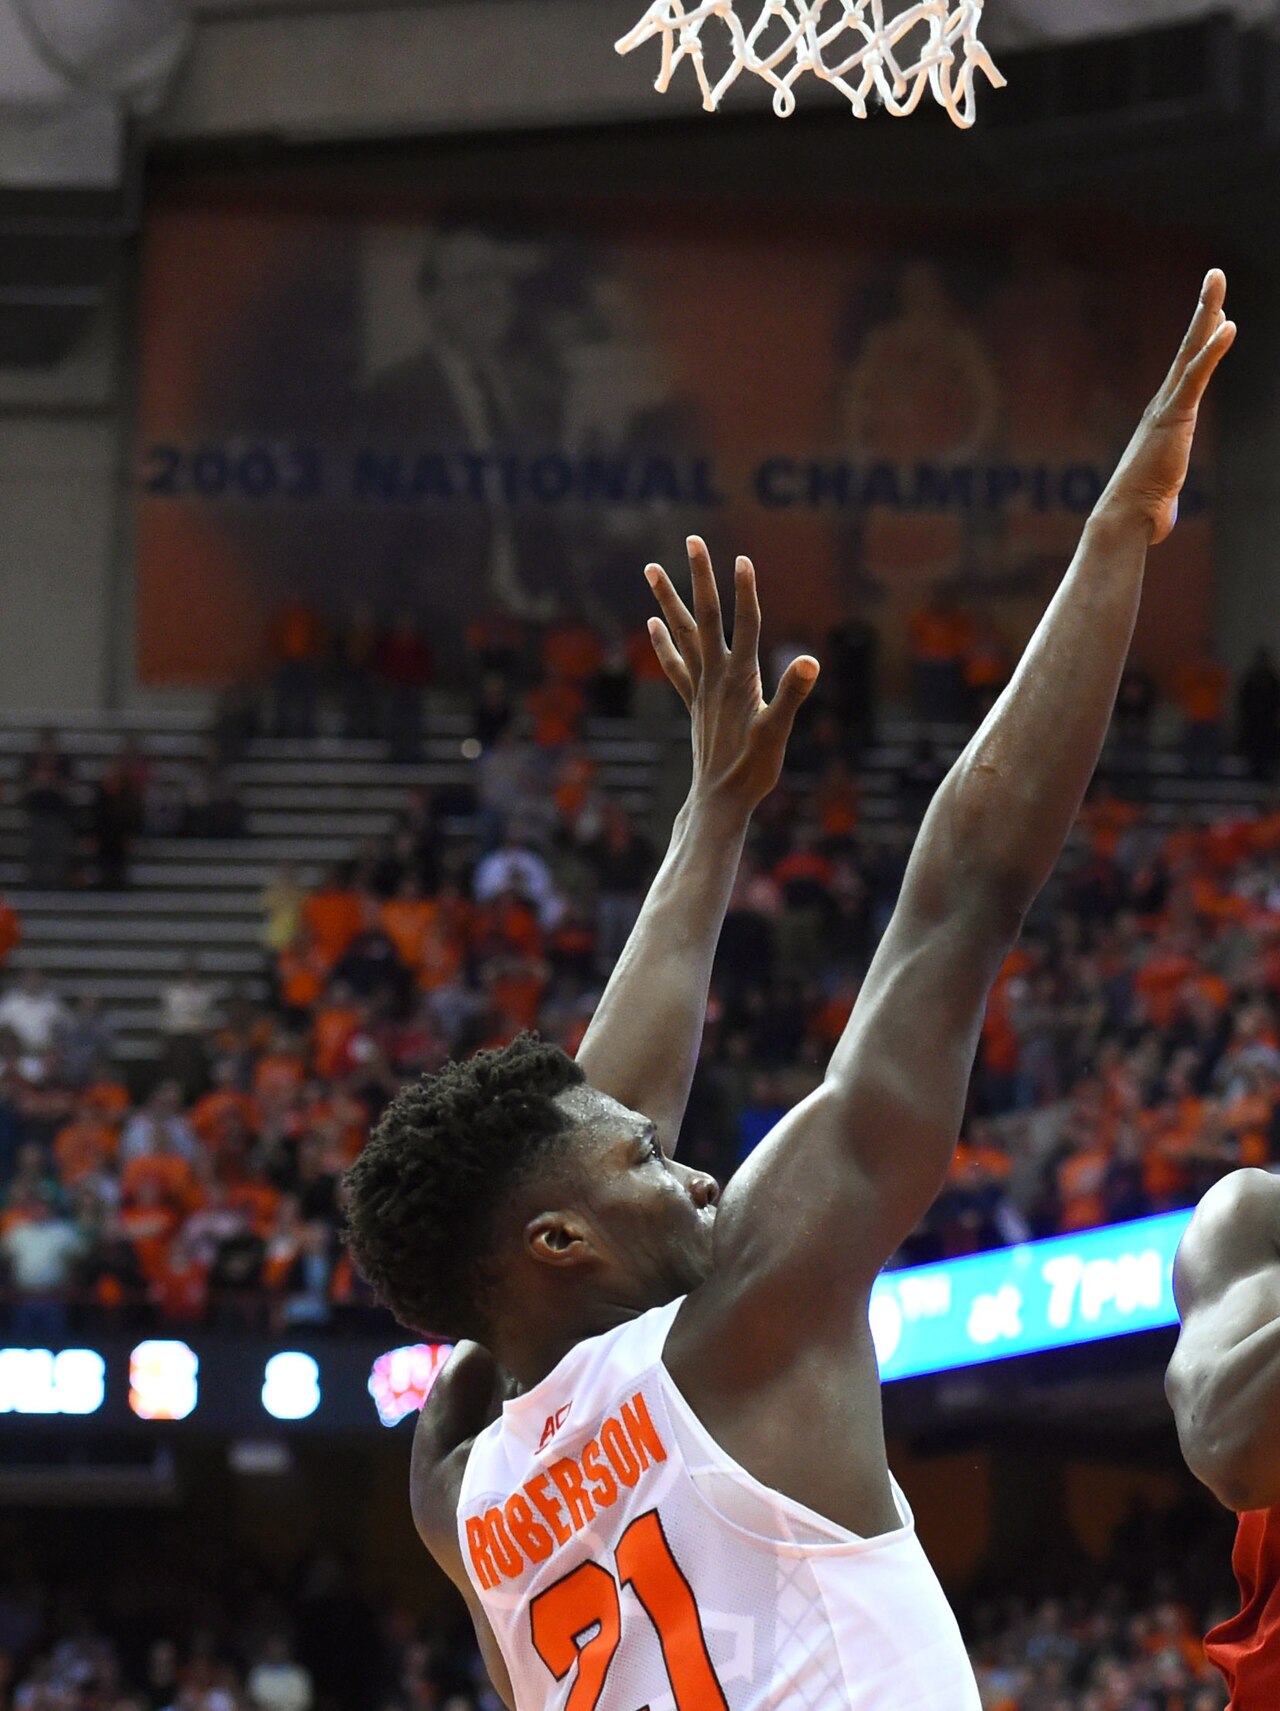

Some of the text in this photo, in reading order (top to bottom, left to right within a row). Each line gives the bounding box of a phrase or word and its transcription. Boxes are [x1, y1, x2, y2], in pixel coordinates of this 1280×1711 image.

[144, 446, 324, 500] 2003
[352, 450, 723, 506] NATIONAL
[465, 1391, 668, 1591] ROBERSON
[529, 1507, 731, 1711] 21
